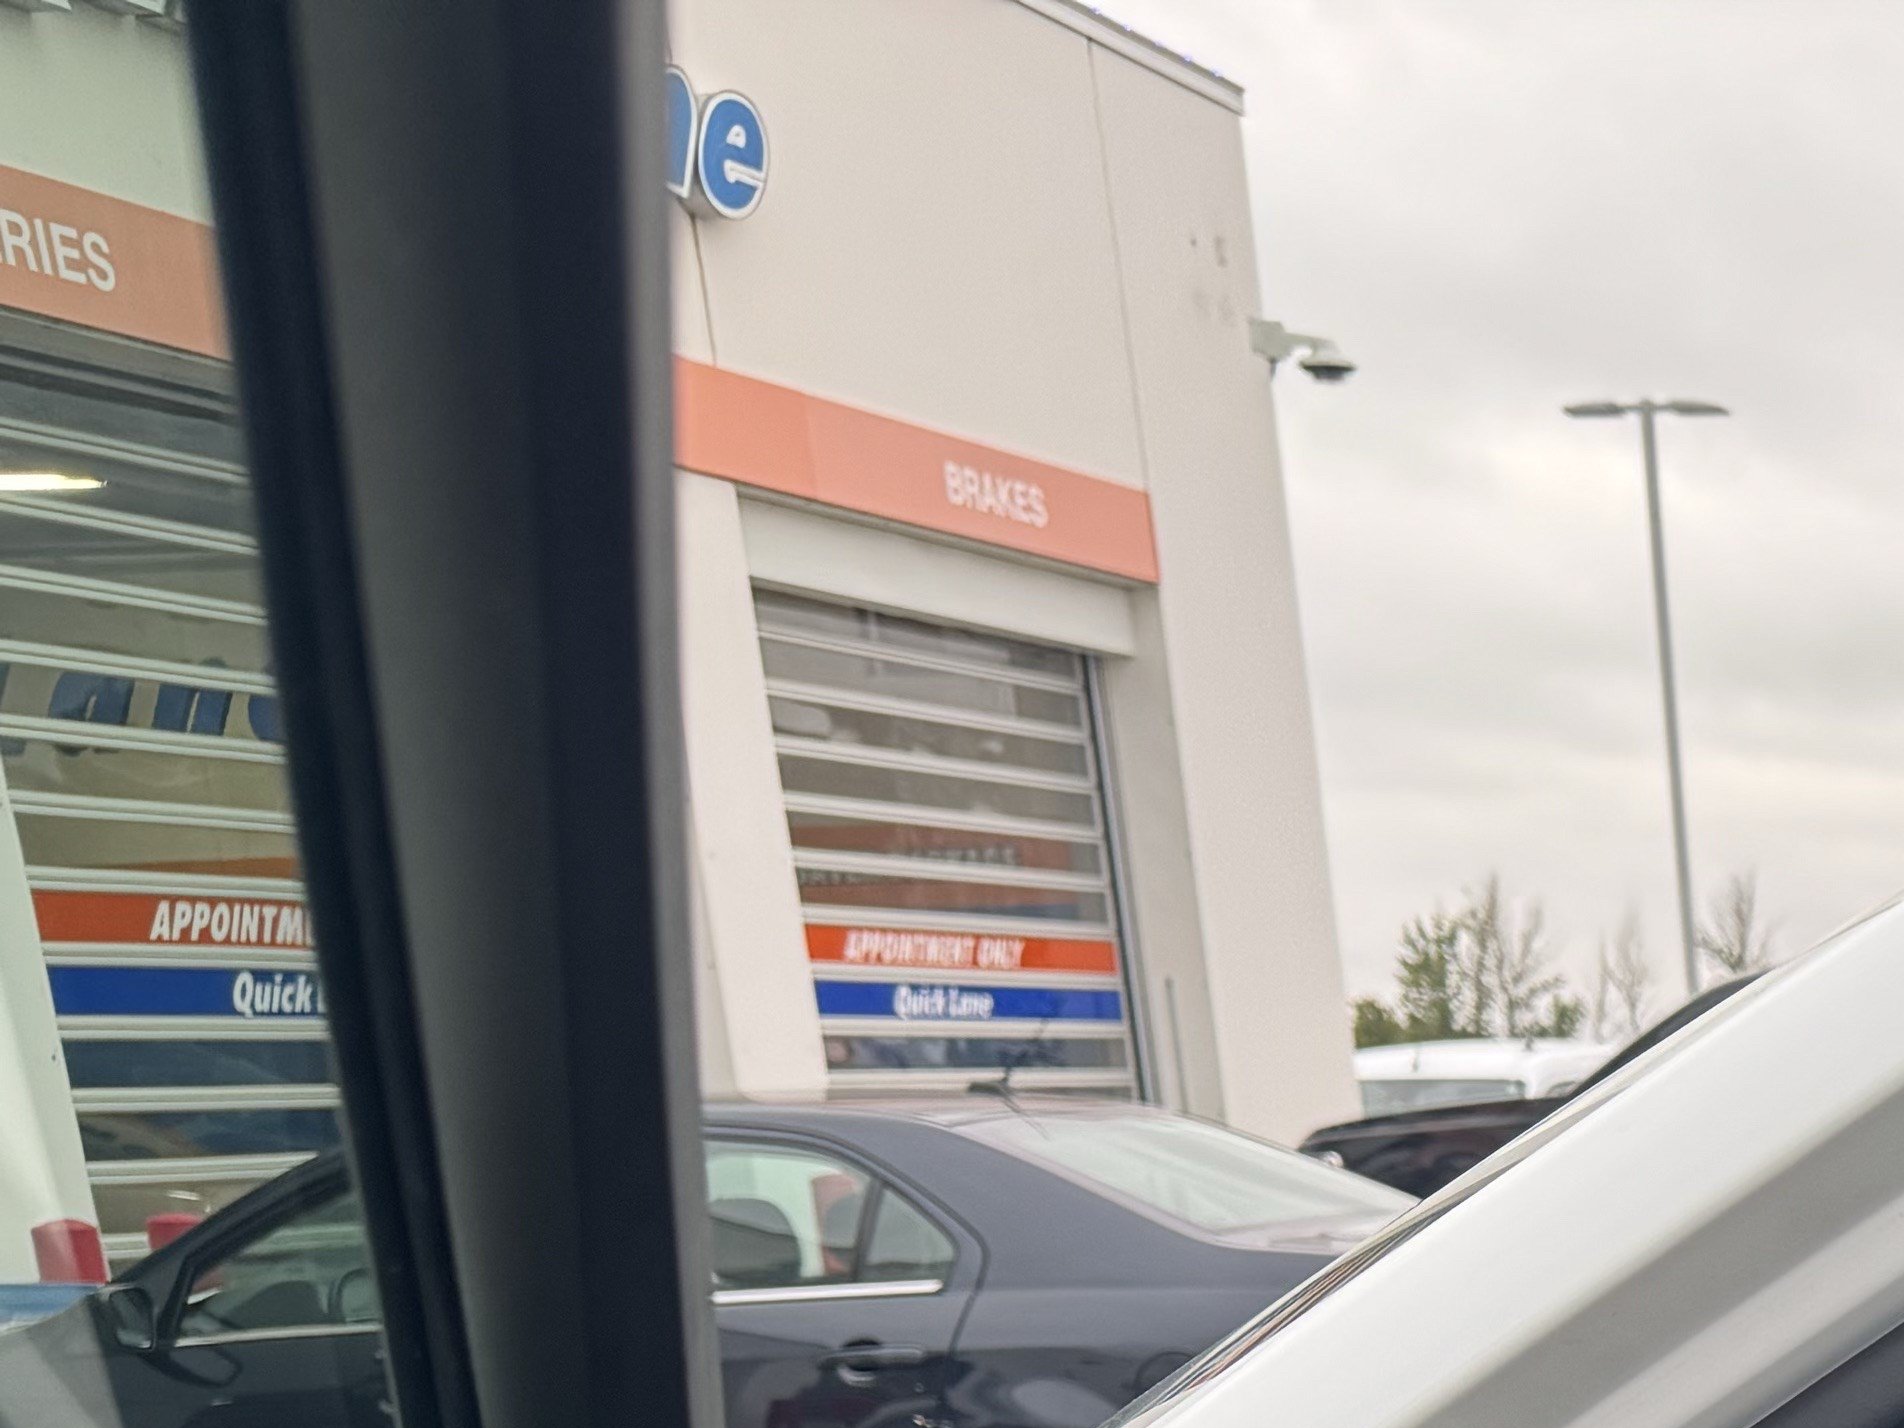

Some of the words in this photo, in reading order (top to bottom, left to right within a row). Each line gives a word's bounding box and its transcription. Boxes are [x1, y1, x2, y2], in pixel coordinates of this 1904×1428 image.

[0, 208, 116, 292] RIES
[944, 459, 1048, 528] BRAKES
[233, 971, 312, 1019] Quick
[893, 983, 944, 1021] Quick
[947, 986, 994, 1019] Lane
